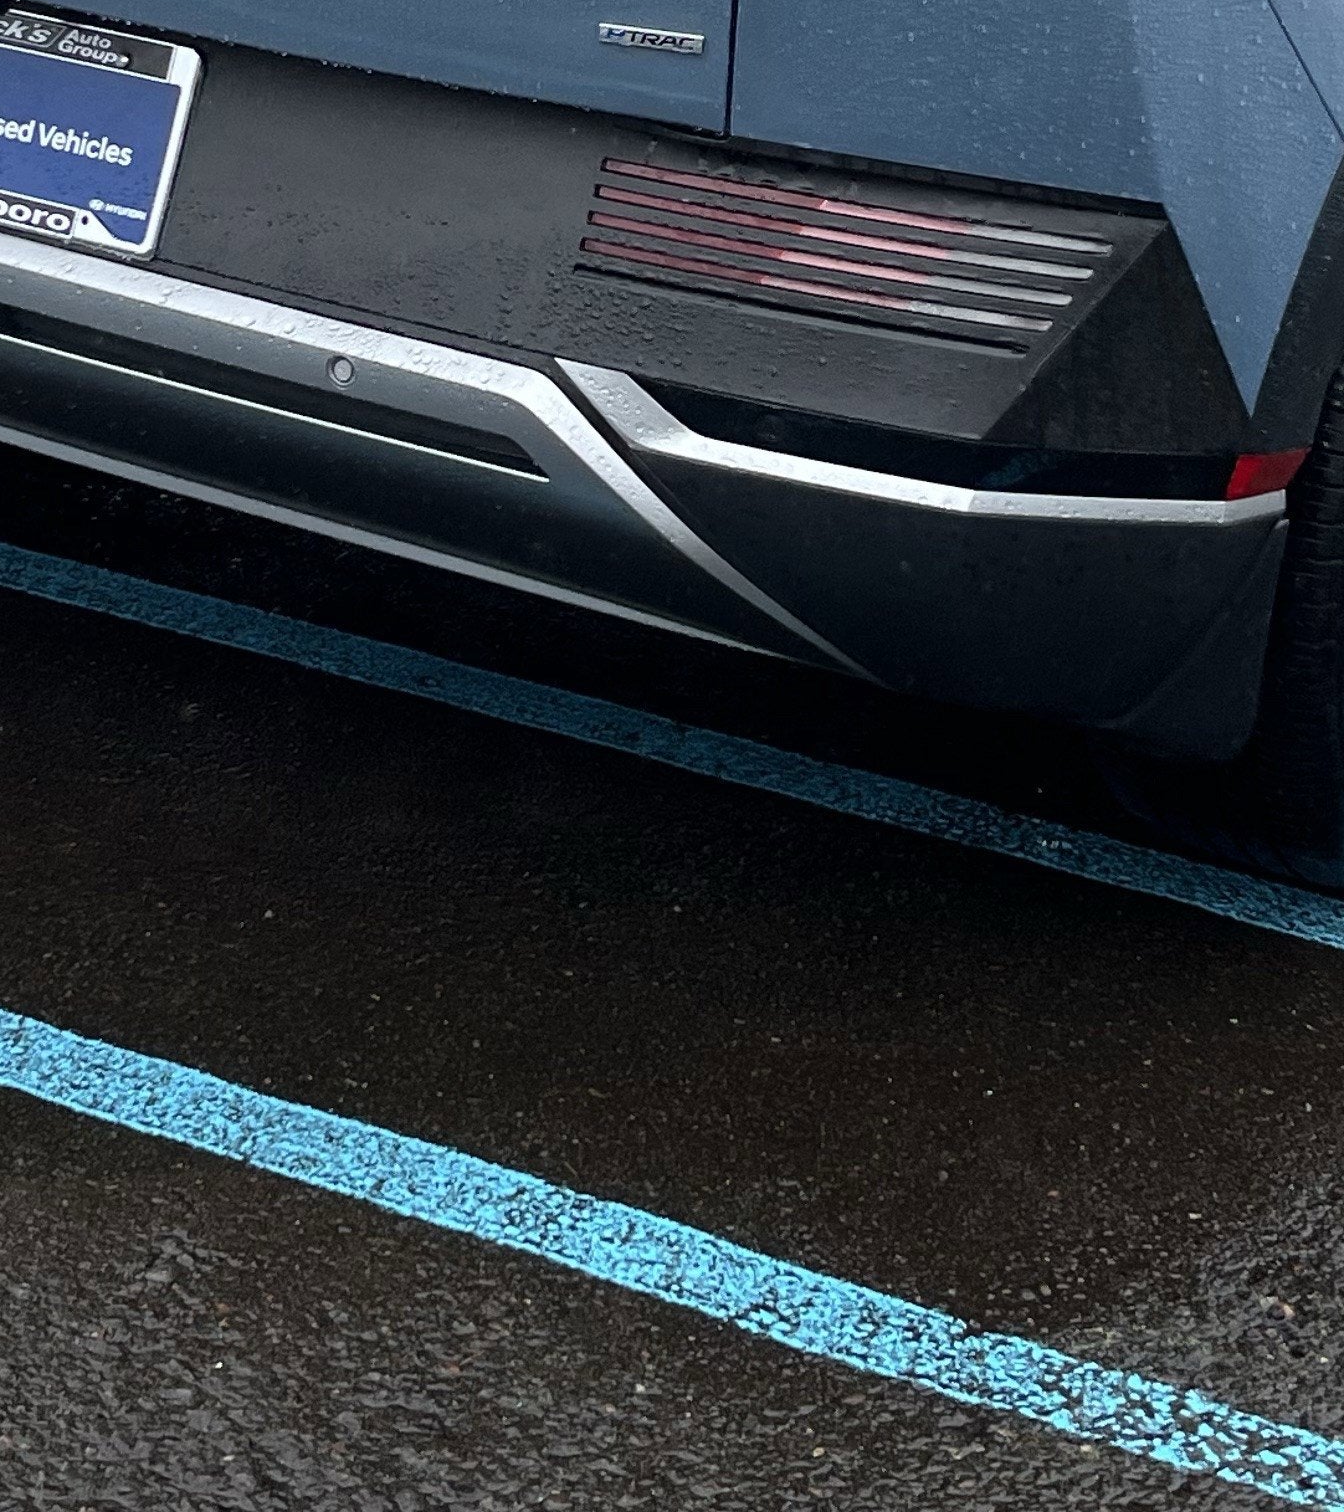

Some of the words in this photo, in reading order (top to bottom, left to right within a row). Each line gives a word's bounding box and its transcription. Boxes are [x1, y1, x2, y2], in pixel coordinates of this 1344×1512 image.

[57, 39, 119, 65] Group
[66, 29, 112, 50] Auto
[38, 122, 134, 167] Vehicles
